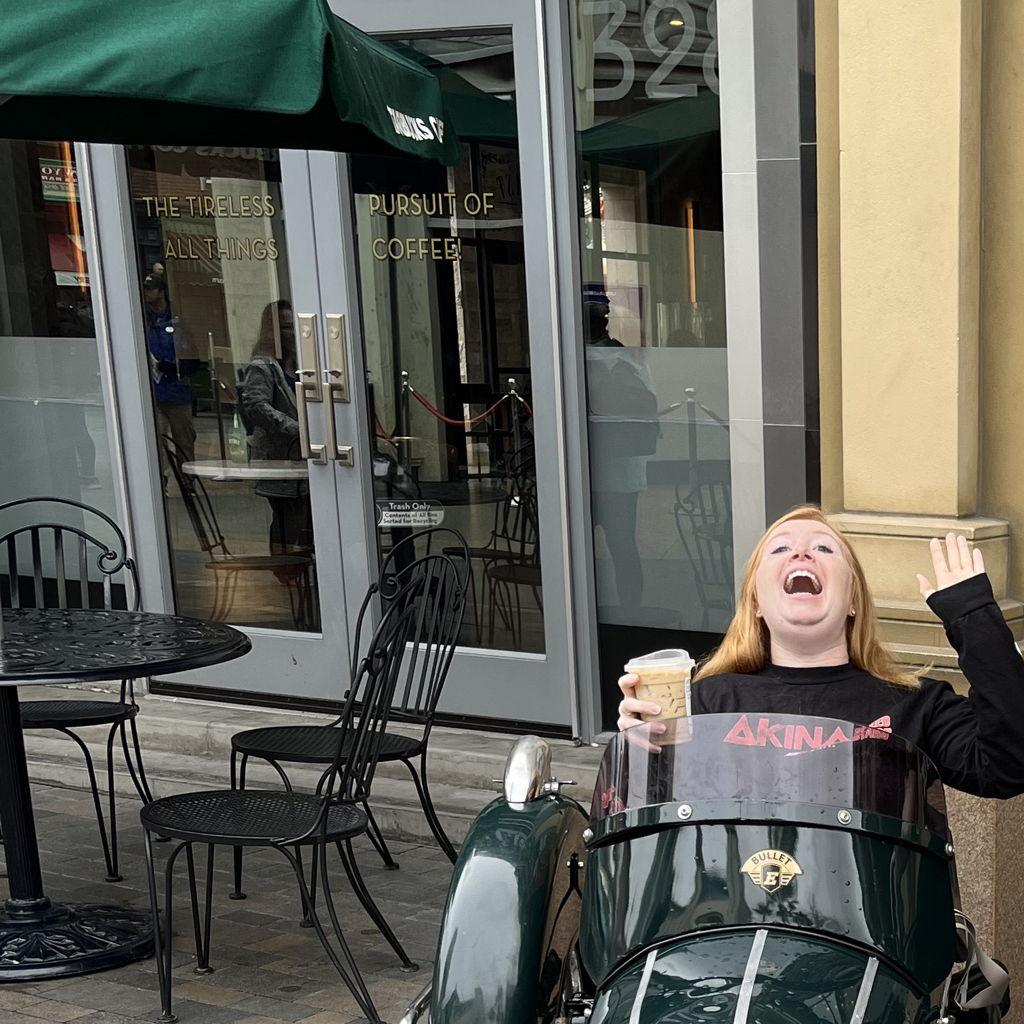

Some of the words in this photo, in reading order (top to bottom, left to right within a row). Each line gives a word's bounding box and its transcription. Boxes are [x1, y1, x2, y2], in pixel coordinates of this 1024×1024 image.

[142, 196, 181, 217] THE
[185, 195, 275, 218] TIRELESS
[369, 192, 456, 216] PURSUIT
[464, 192, 494, 216] OF
[165, 238, 200, 259] ALL
[203, 237, 279, 260] THINGS
[372, 237, 462, 260] COFFEE!
[388, 502, 411, 510] Trash
[412, 502, 431, 512] Only
[722, 712, 849, 750] AKINA
[751, 851, 792, 865] BULLET
[763, 871, 780, 886] E
